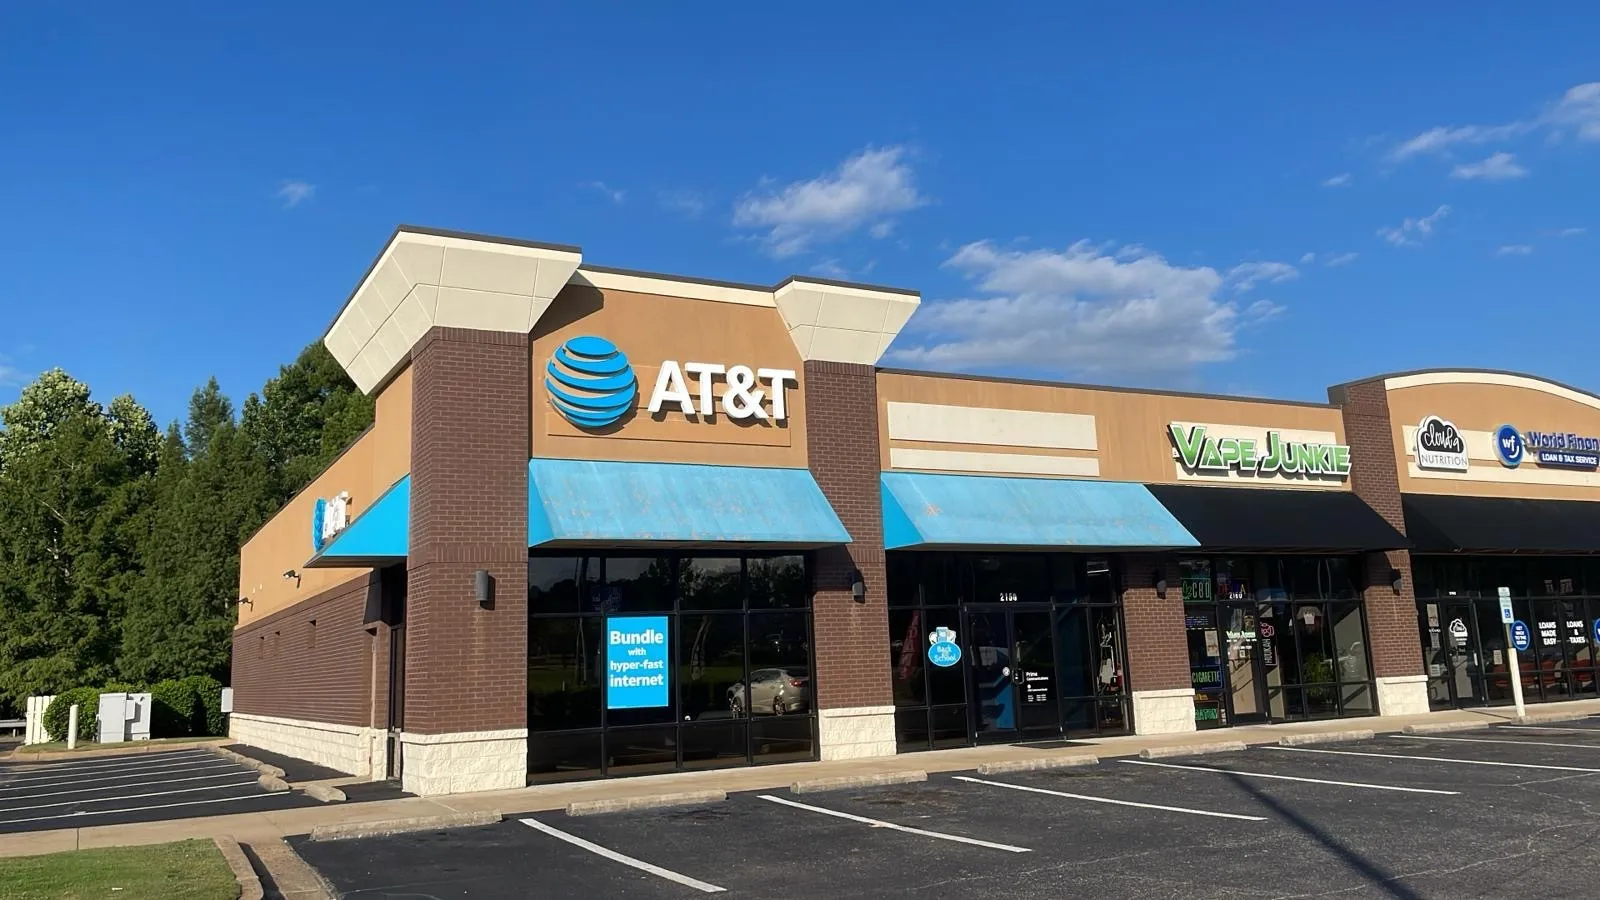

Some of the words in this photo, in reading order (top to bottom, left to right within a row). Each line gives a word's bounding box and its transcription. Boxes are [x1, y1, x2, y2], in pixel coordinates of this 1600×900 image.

[648, 360, 796, 420] AT&T
[1528, 431, 1565, 449] World
[1567, 433, 1600, 451] Finan
[1170, 424, 1257, 471] VAPE
[1261, 431, 1352, 475] JUNKIE
[1421, 454, 1468, 466] NUTRITION
[1542, 453, 1558, 462] LOAN
[1564, 455, 1575, 463] TAX
[1575, 456, 1598, 465] SERVICE
[1538, 621, 1556, 629] LOANS
[1566, 620, 1584, 628] LOANS
[610, 629, 664, 645] Bundle
[1543, 638, 1557, 646] EASY
[627, 648, 647, 656] with
[934, 653, 957, 663] School
[610, 659, 664, 673] hyper-fast
[610, 674, 664, 688] internet
